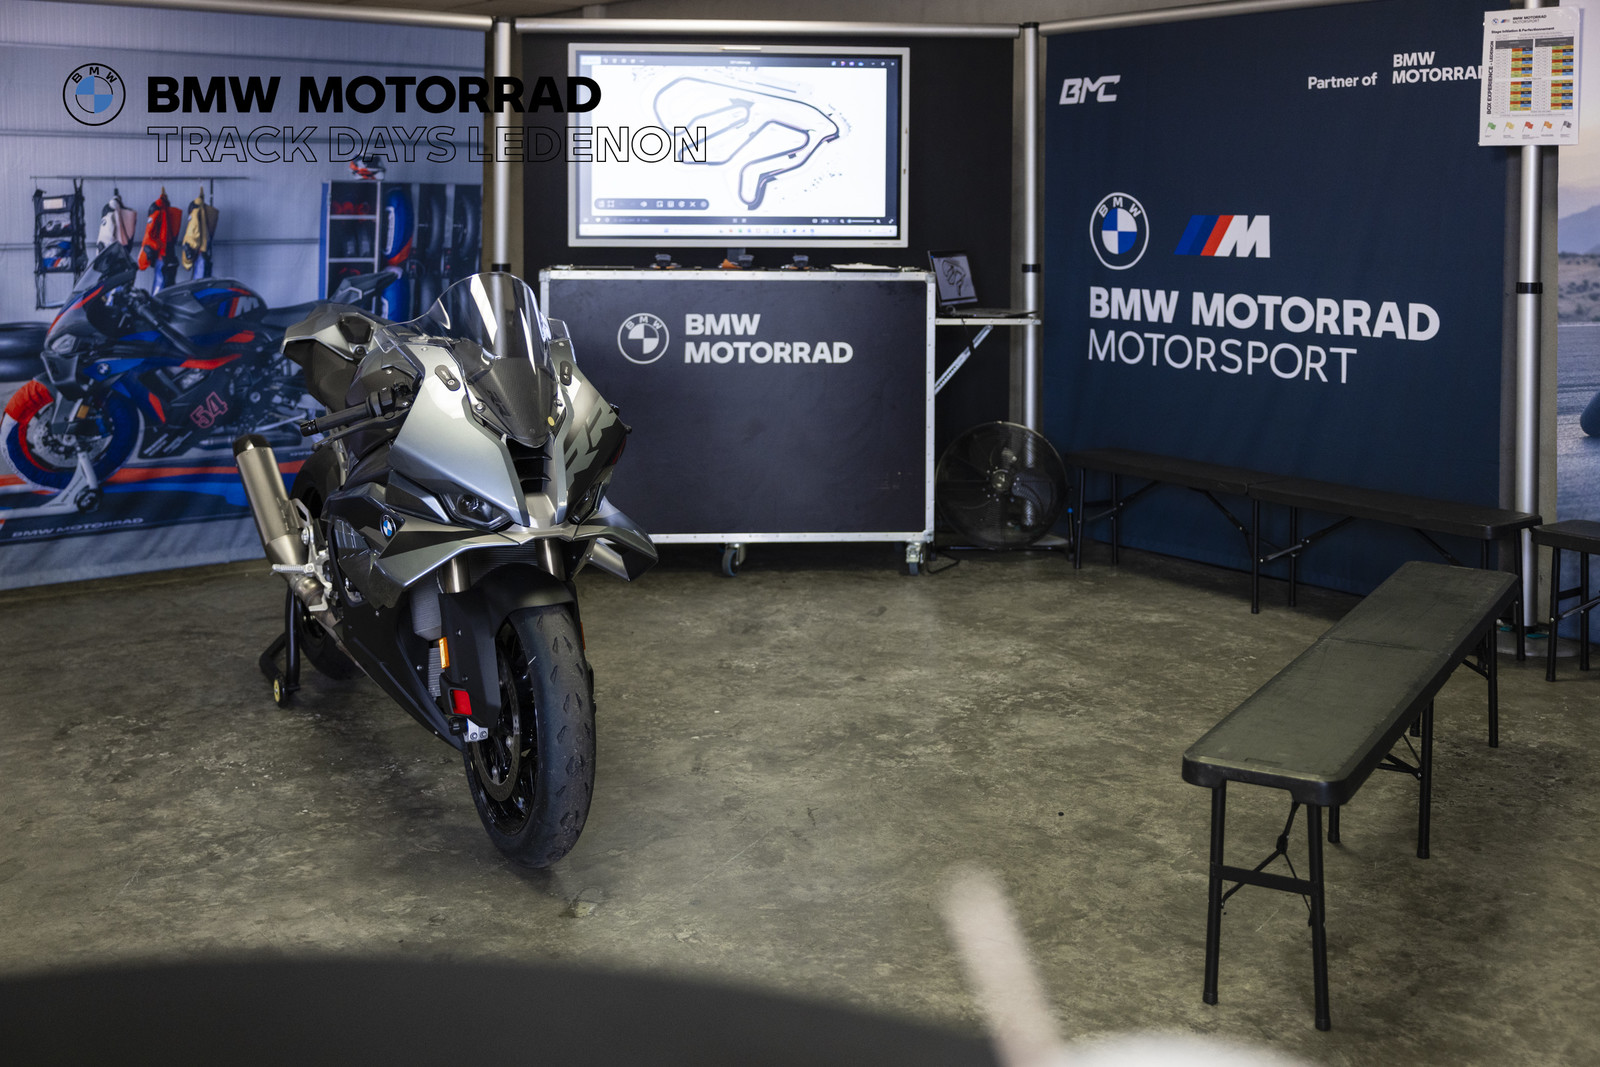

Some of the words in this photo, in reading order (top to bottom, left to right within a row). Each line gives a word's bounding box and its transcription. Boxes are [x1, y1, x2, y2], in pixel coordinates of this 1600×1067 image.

[1393, 51, 1435, 68] BMW
[1059, 74, 1121, 105] BMC
[1308, 76, 1359, 90] Partner
[1361, 72, 1378, 86] of
[1098, 197, 1141, 218] BMW
[625, 315, 663, 330] BMW
[685, 313, 761, 336] BMW
[1089, 286, 1179, 323] BMW
[1191, 291, 1440, 341] MOTORRAD
[684, 341, 854, 364] MOTORRAD
[1088, 328, 1358, 384] MOTORSPORT
[190, 391, 228, 429] 54
[12, 528, 54, 537] BMW
[56, 517, 144, 533] MOTORRAD
